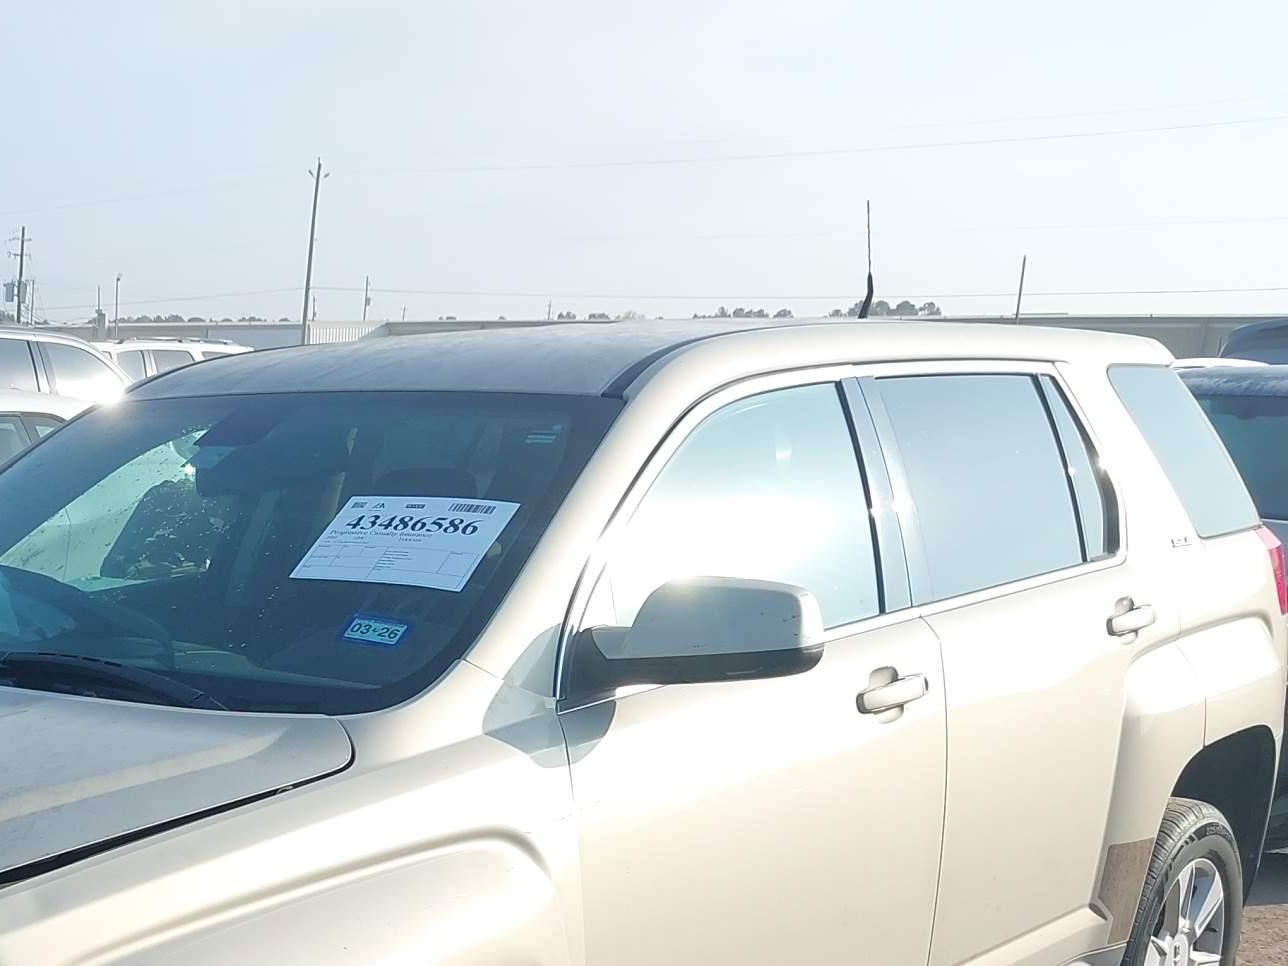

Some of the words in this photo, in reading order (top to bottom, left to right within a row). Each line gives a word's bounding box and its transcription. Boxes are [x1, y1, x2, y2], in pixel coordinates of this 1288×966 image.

[346, 514, 484, 536] 43486586
[349, 622, 370, 635] 03
[378, 627, 401, 640] 26
